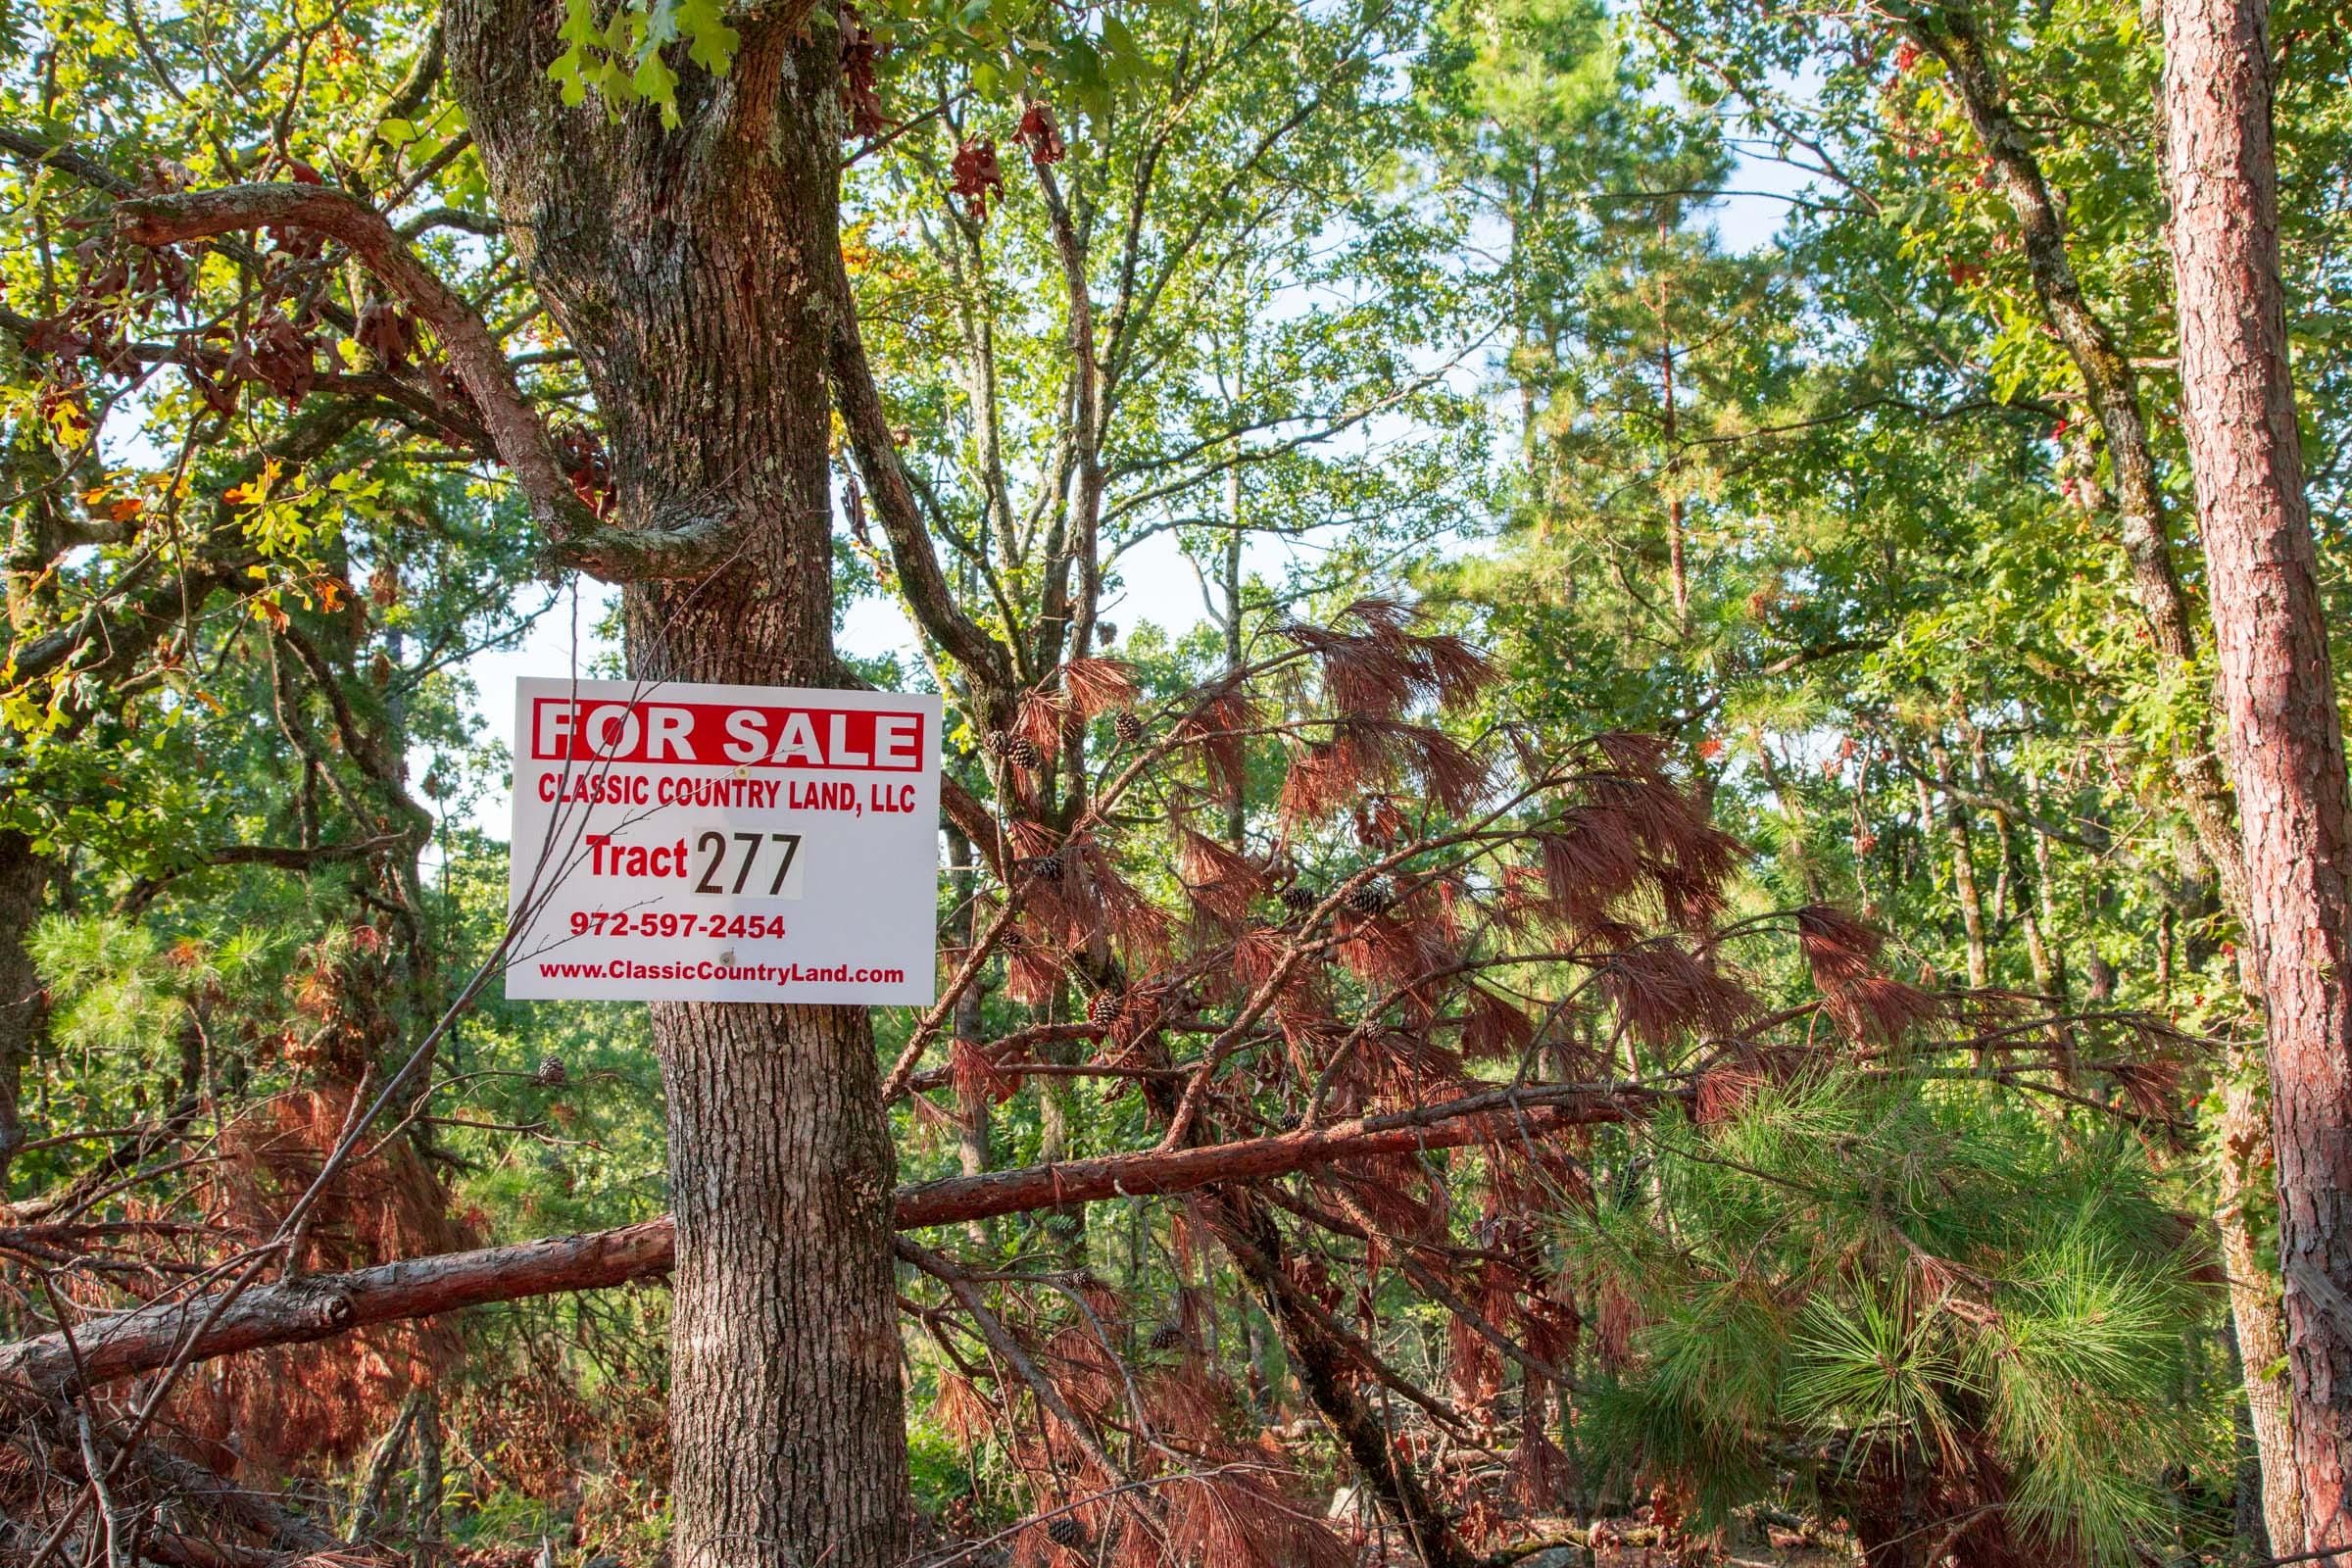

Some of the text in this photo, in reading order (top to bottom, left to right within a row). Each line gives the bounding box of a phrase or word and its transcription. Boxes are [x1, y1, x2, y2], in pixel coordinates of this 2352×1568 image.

[538, 702, 919, 767] FOR SALE
[538, 772, 916, 817] CLASSIC COUNTRY LAND, LLC
[585, 830, 803, 896] Tract 277
[569, 911, 786, 940] 972-597-2454
[539, 959, 905, 986] www.ClassicCountryLand.com
